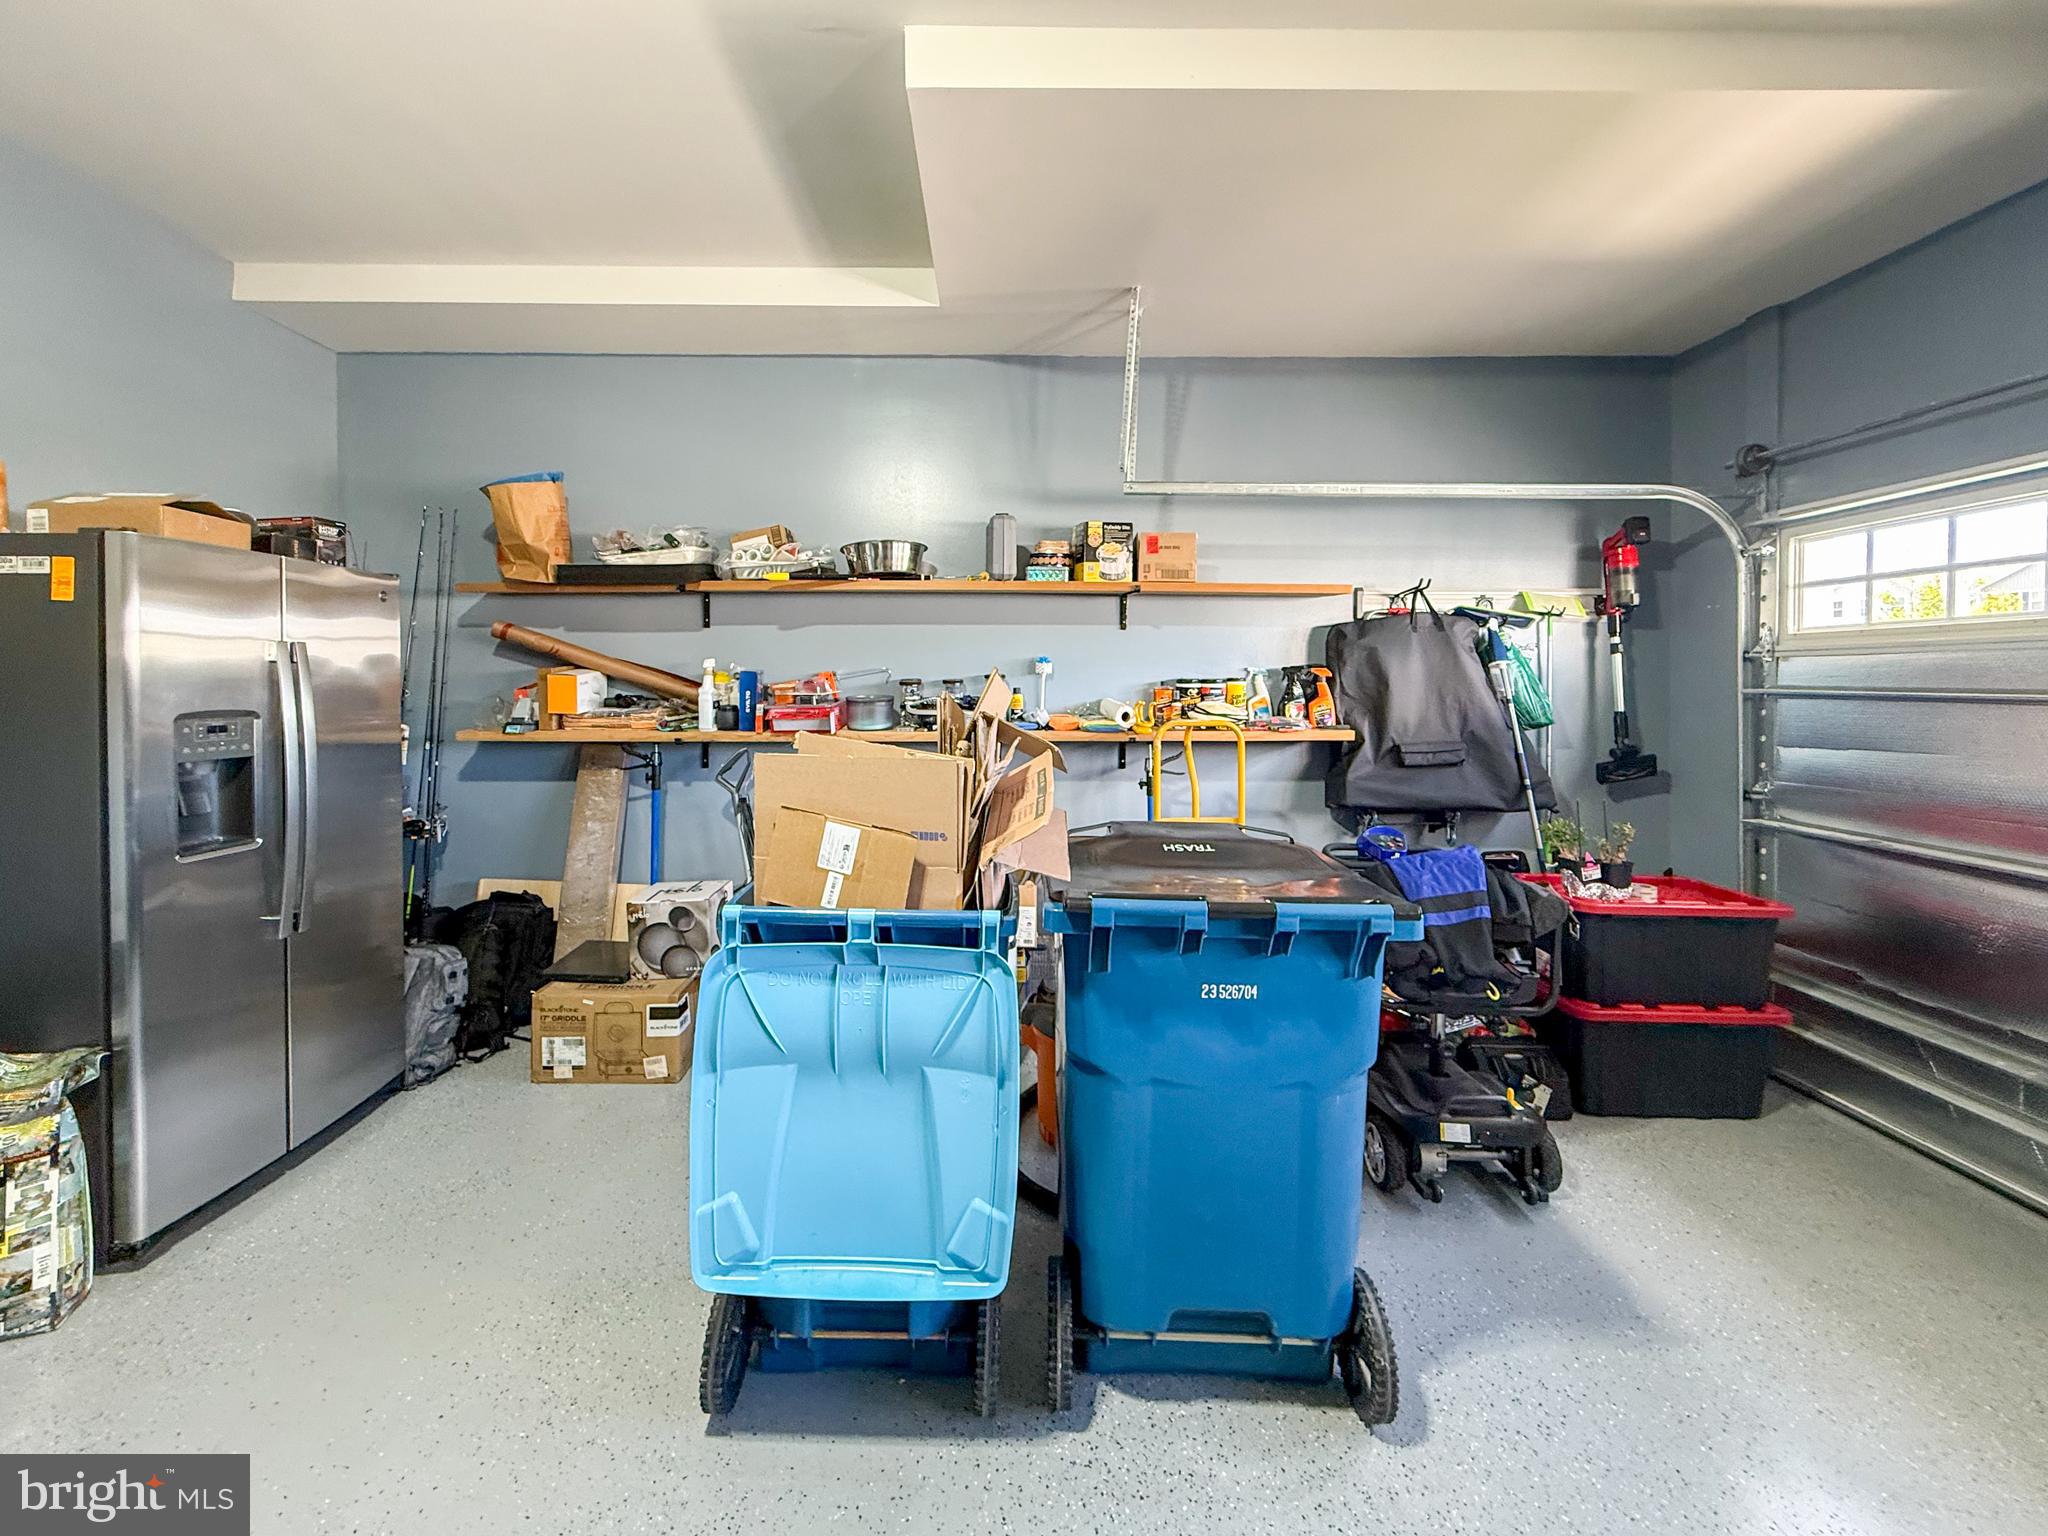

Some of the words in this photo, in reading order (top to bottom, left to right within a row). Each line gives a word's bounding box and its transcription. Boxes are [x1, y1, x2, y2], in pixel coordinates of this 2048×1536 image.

[1162, 843, 1216, 852] TRASH
[767, 970, 793, 987] DO
[841, 971, 883, 987] ROLL
[892, 973, 936, 989] WITH
[942, 976, 970, 991] LID
[840, 990, 880, 1006] OPE
